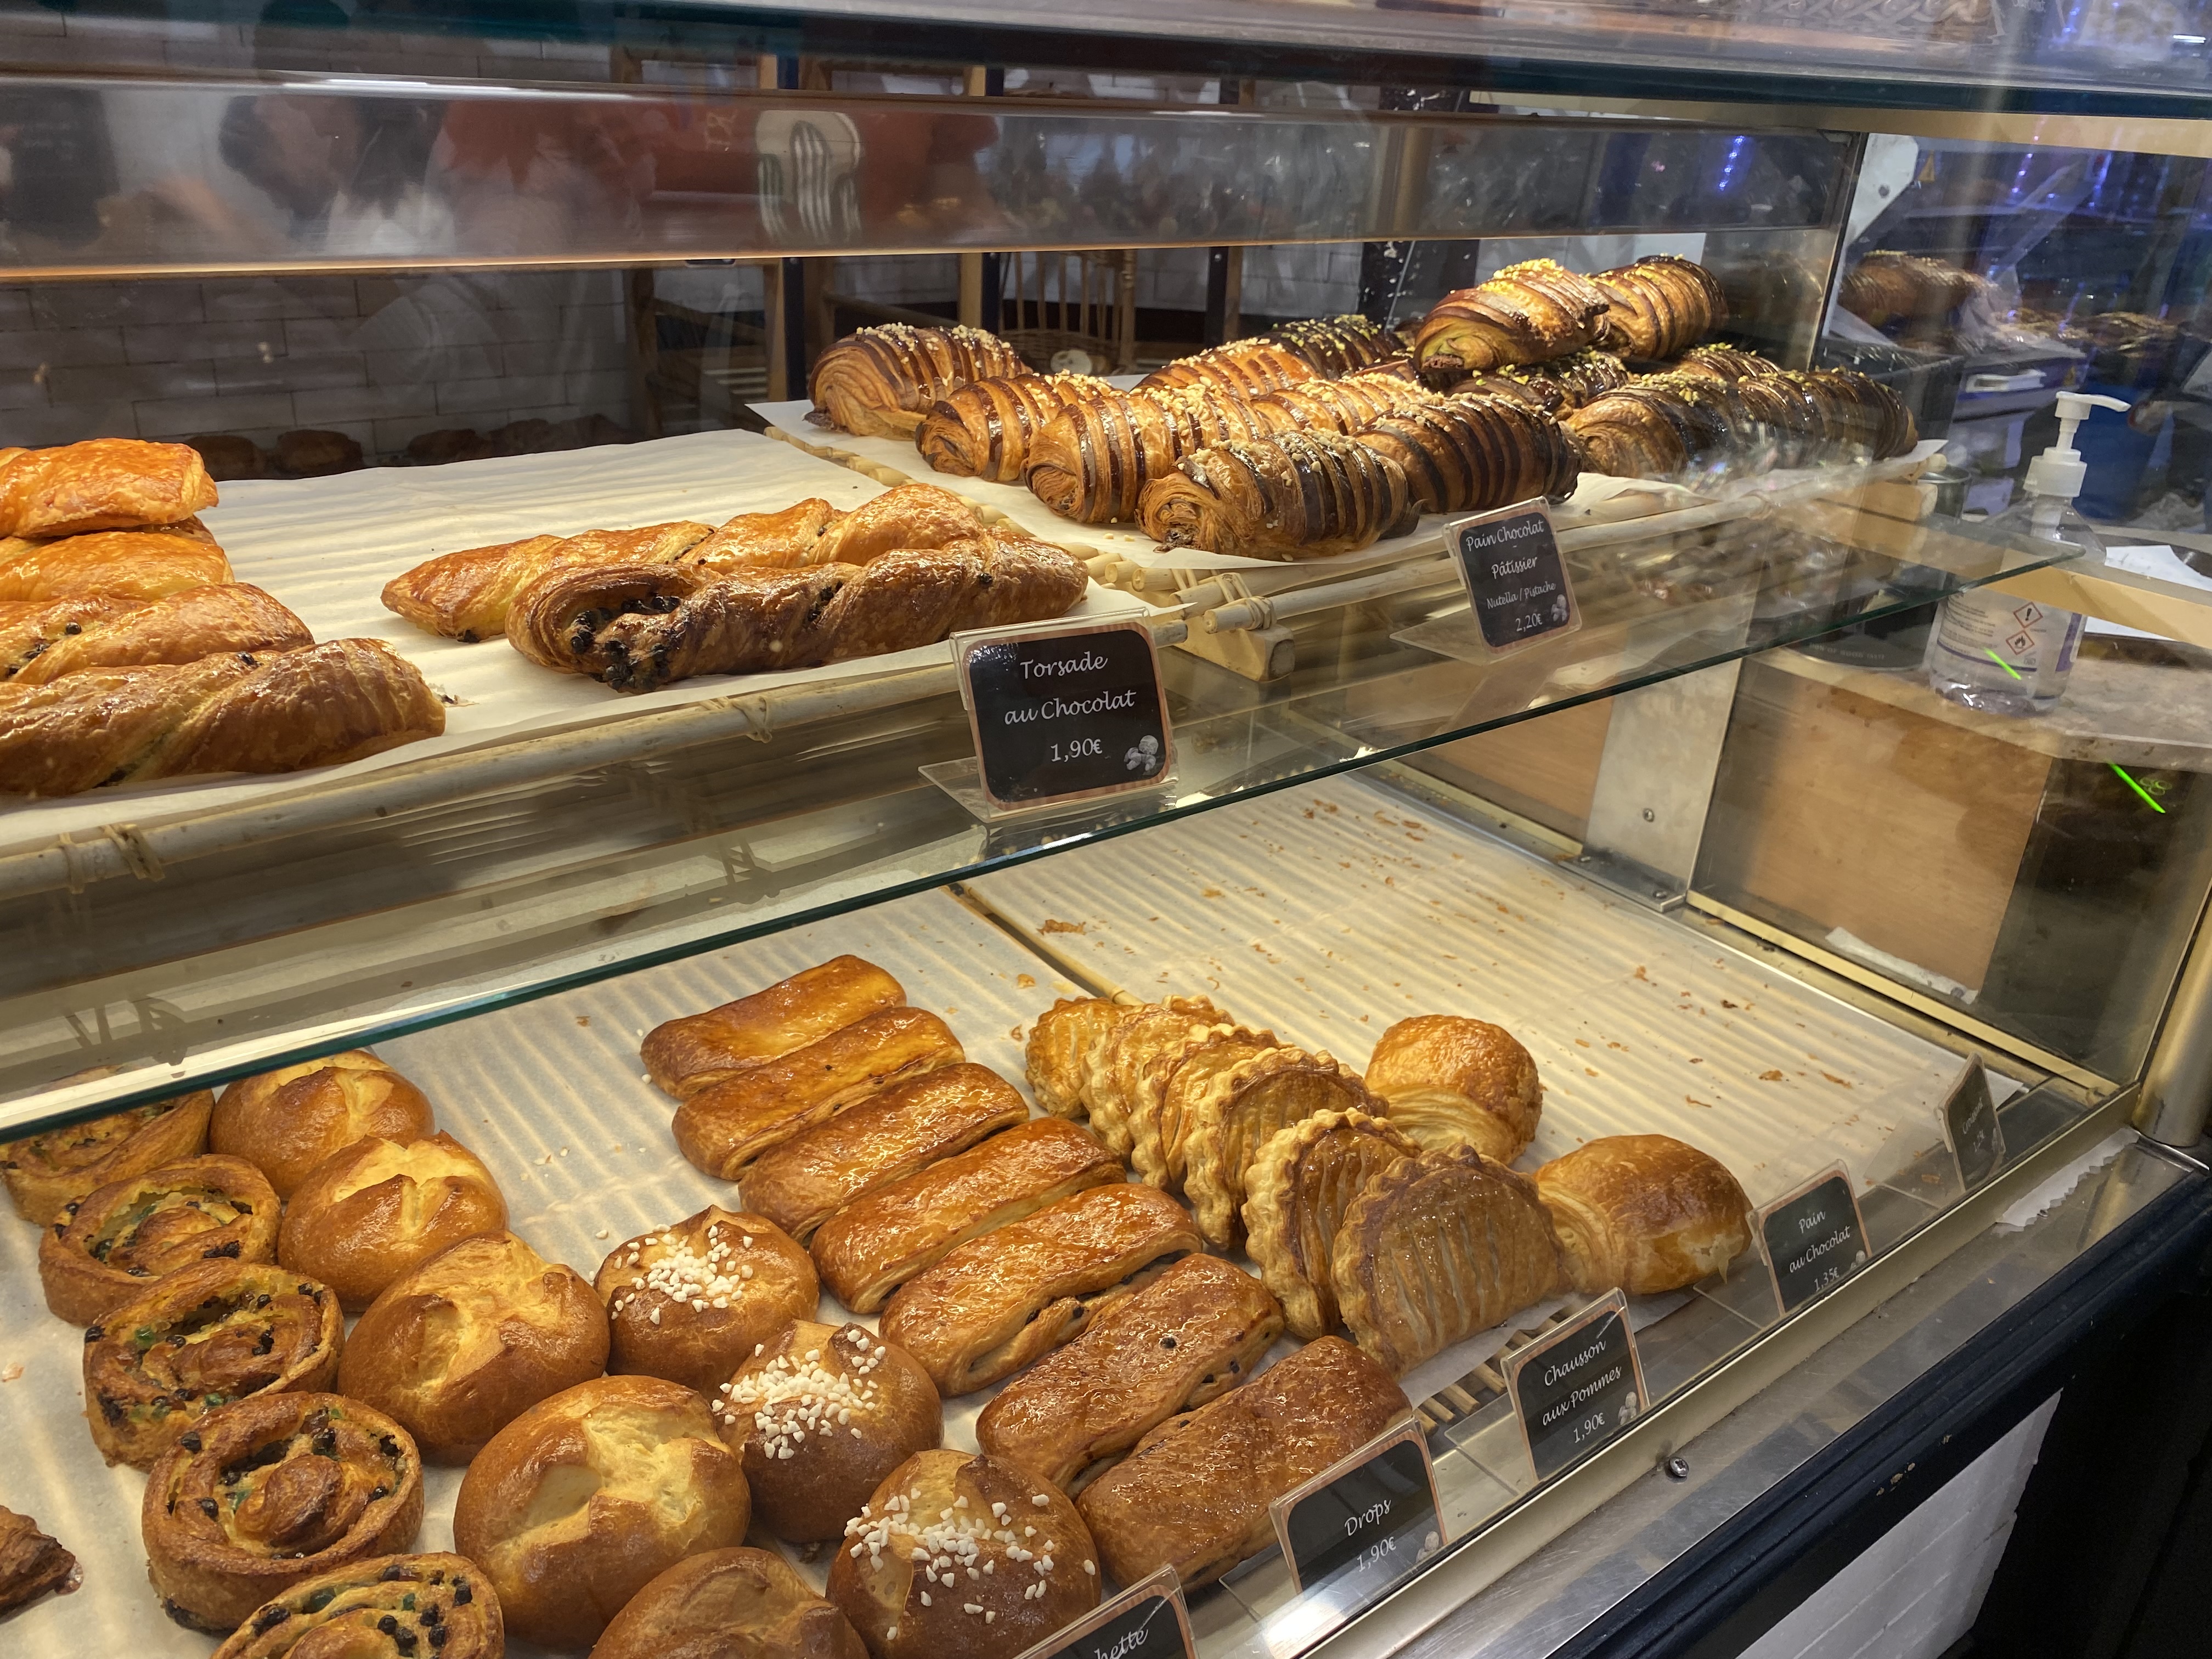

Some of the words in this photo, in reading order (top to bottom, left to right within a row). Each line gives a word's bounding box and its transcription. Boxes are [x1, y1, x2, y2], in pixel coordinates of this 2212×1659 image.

[1466, 535, 1497, 551] Pain
[1497, 520, 1544, 541] Chocolat
[1492, 557, 1537, 579] Pâtissier
[1486, 592, 1518, 610] Nutella
[1523, 581, 1556, 599] Pistache
[1515, 613, 1543, 632] 2,20€
[1020, 651, 1108, 679] Torsade
[1005, 708, 1039, 725] au
[1041, 689, 1136, 720] Chocolat
[1051, 738, 1103, 763] 1,90€
[1798, 1210, 1826, 1234] Pain
[1789, 1256, 1806, 1273] au
[1805, 1225, 1850, 1262] Chocolat
[1814, 1267, 1839, 1292] 1,35€
[1544, 1340, 1606, 1386] Chausson
[1542, 1401, 1570, 1426] aux
[1570, 1365, 1622, 1408] Pommes
[1573, 1412, 1605, 1443] 1,90€
[1344, 1499, 1391, 1536] Drops
[1356, 1536, 1397, 1572] 1,90€
